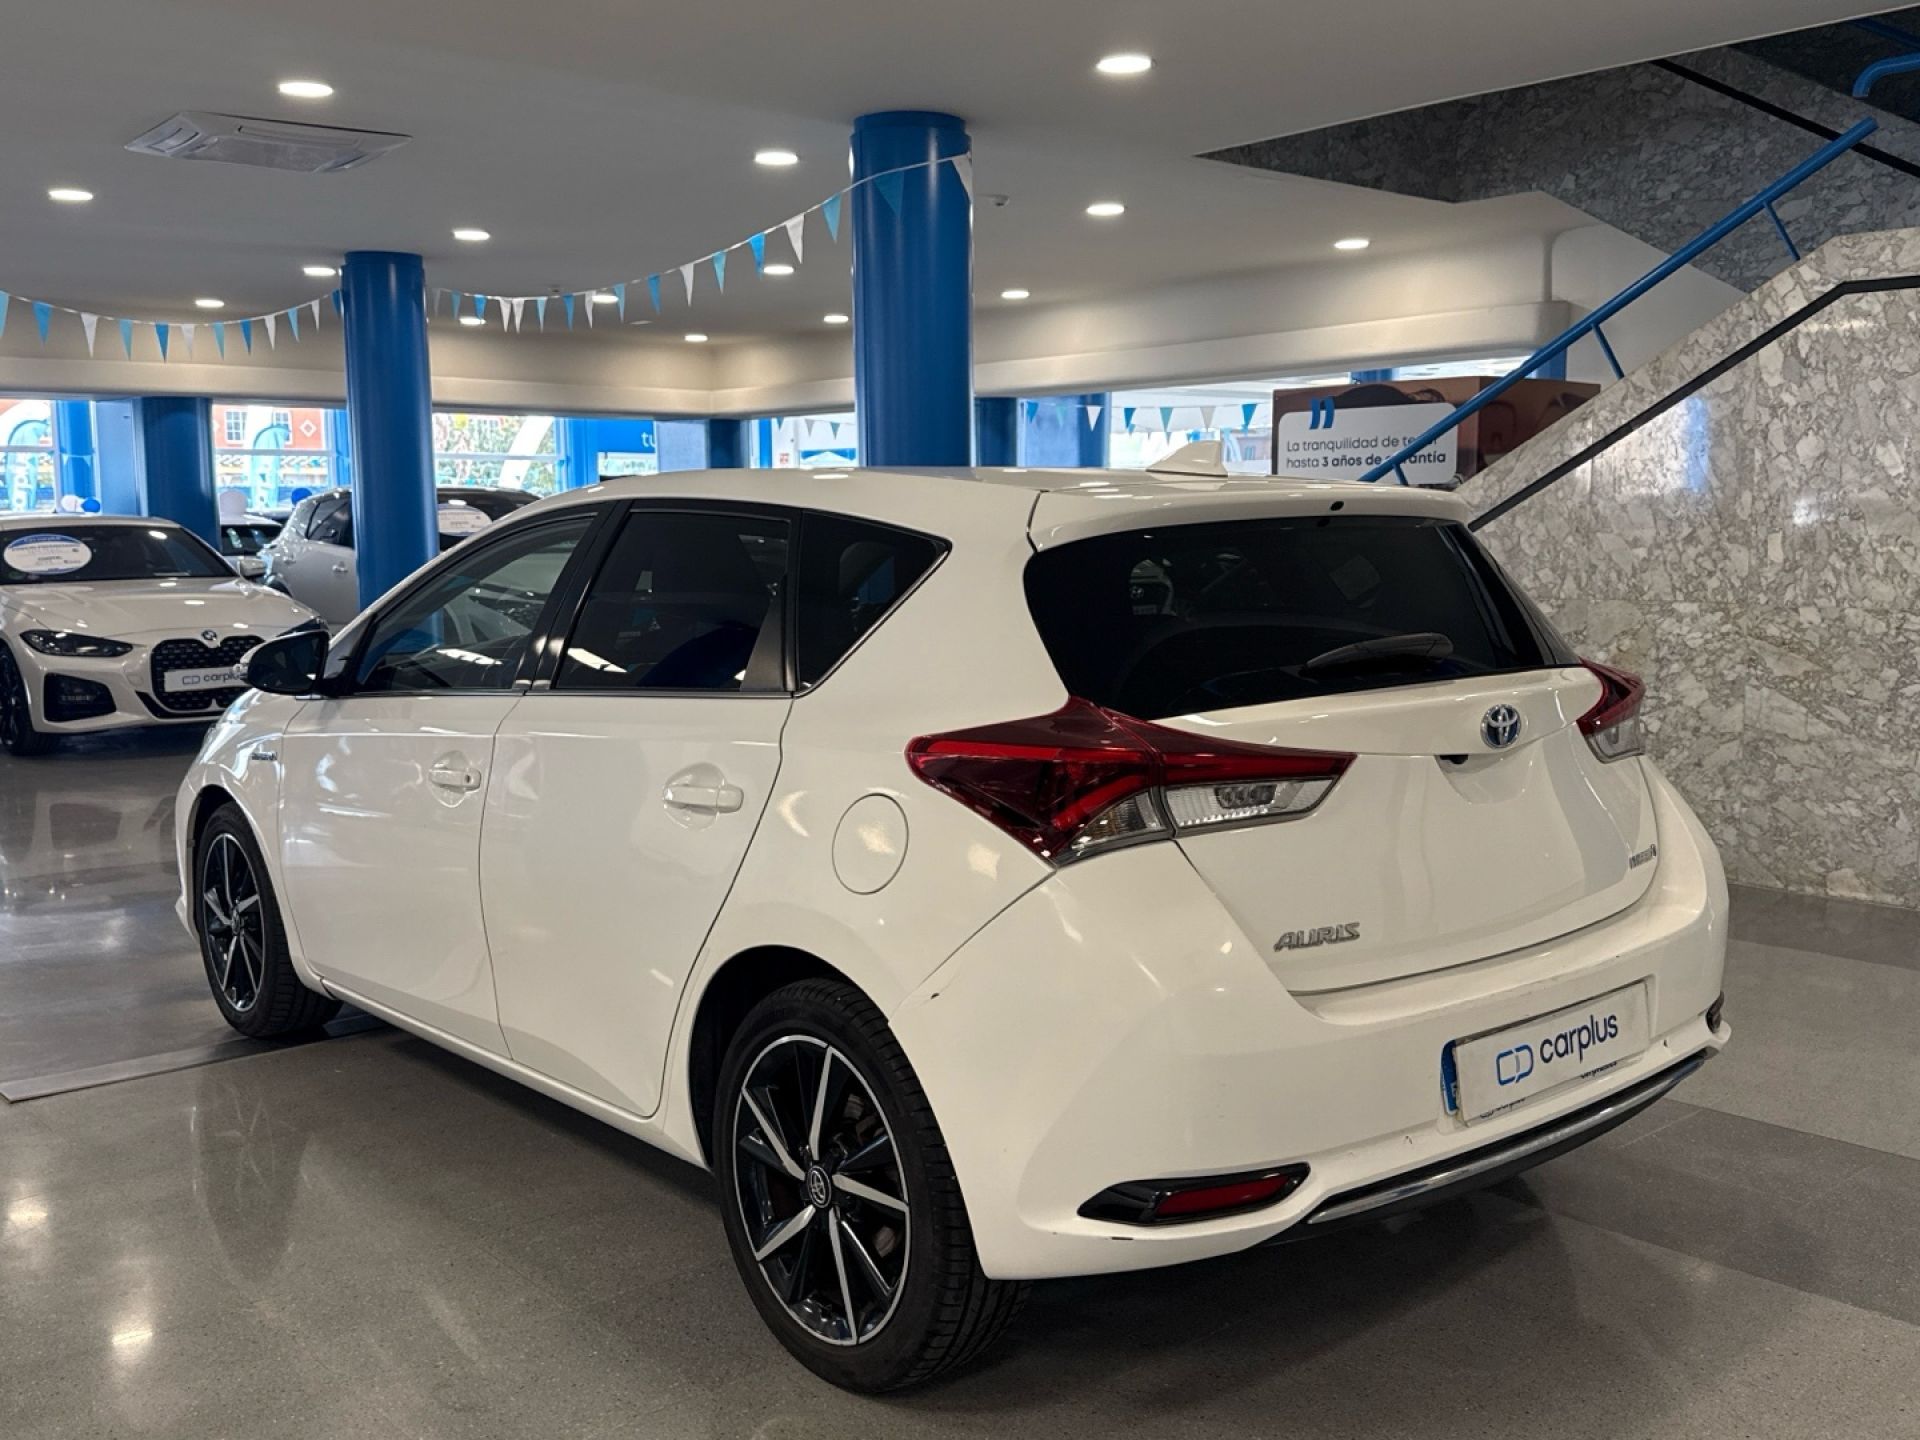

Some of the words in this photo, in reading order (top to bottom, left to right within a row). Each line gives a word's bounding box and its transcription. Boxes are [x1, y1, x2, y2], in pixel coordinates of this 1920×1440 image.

[1287, 441, 1299, 452] La
[1302, 436, 1377, 453] tranquilidad
[1381, 435, 1399, 448] de
[1287, 457, 1319, 469] hasta
[1321, 456, 1329, 467] 3
[1331, 454, 1362, 467] años
[1365, 453, 1381, 466] de
[1273, 922, 1360, 952] AURIS
[1539, 1014, 1618, 1064] carplus
